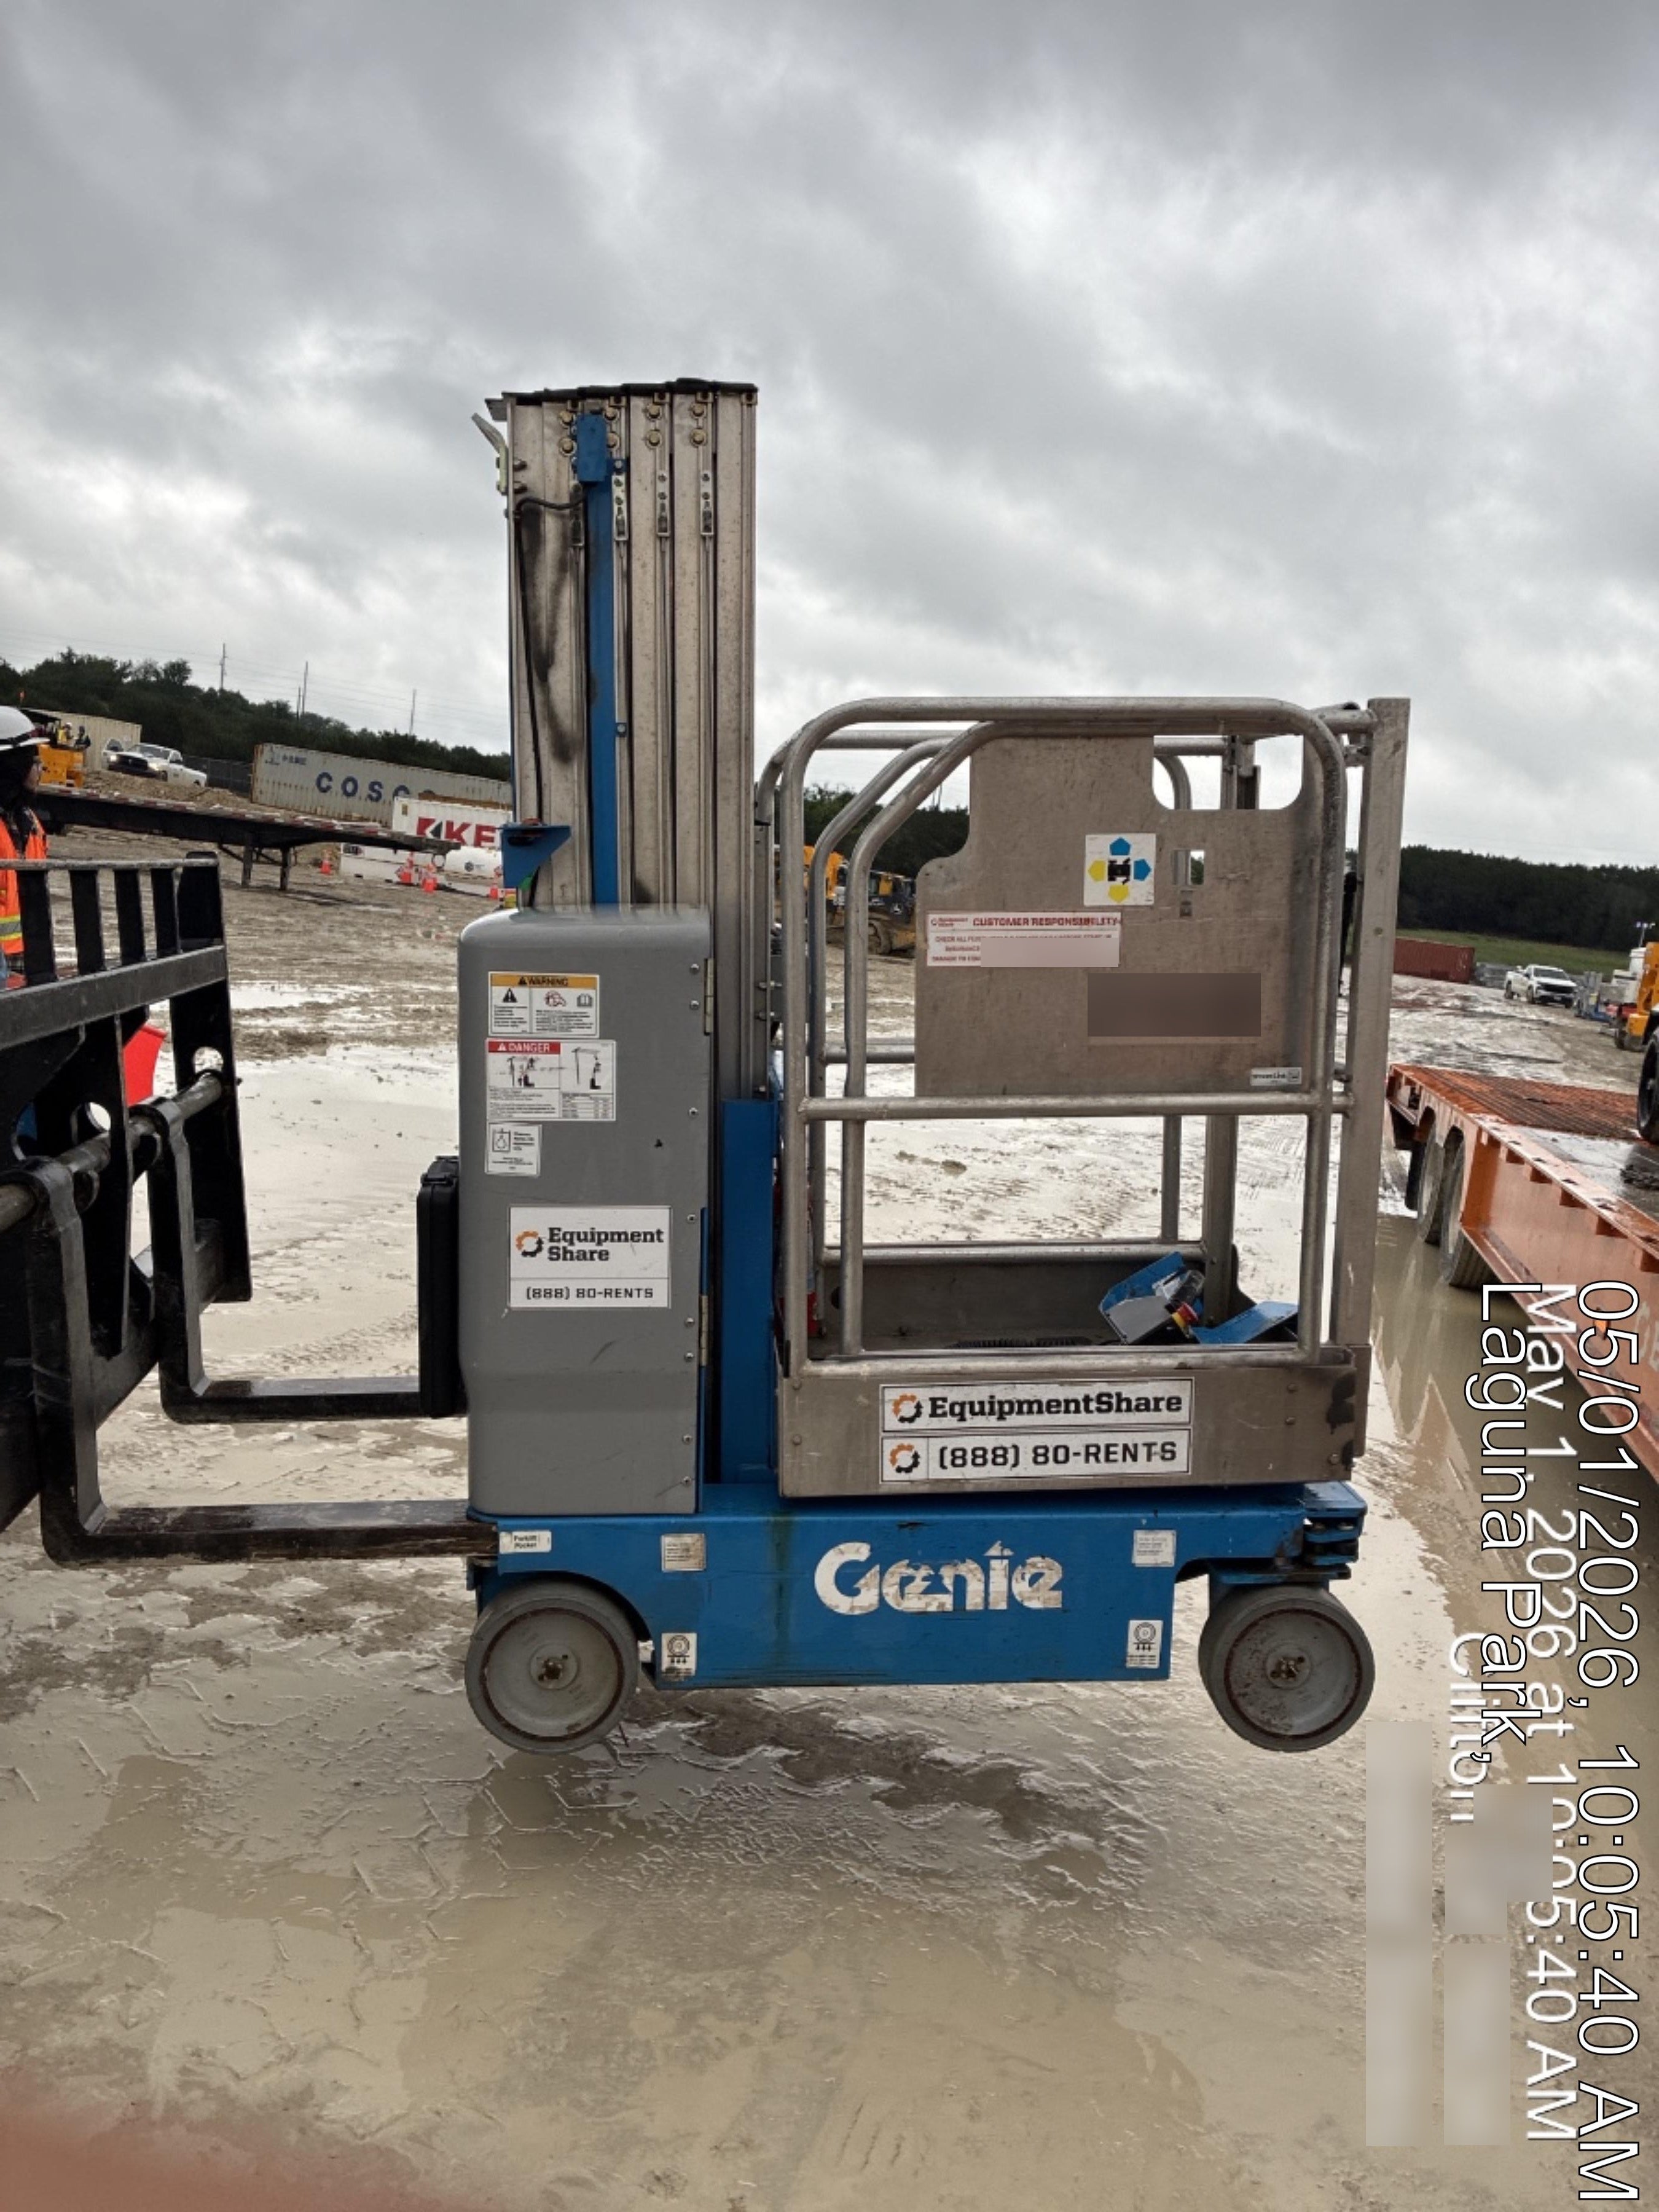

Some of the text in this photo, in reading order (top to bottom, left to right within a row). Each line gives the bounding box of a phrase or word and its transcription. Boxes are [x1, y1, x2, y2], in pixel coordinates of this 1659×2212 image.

[316, 772, 435, 802] COSC
[973, 918, 1029, 927] CUSTOMER
[527, 976, 568, 987] WARNING
[508, 1043, 551, 1053] DANGER
[547, 1228, 664, 1246] Equipment
[547, 1245, 610, 1261] Share
[526, 1287, 654, 1300] (888) 80-RENTS
[928, 1392, 1183, 1421] EquipmentShare
[939, 1441, 1177, 1470] (888) 80-RENTS
[814, 1540, 1063, 1616] Genie
